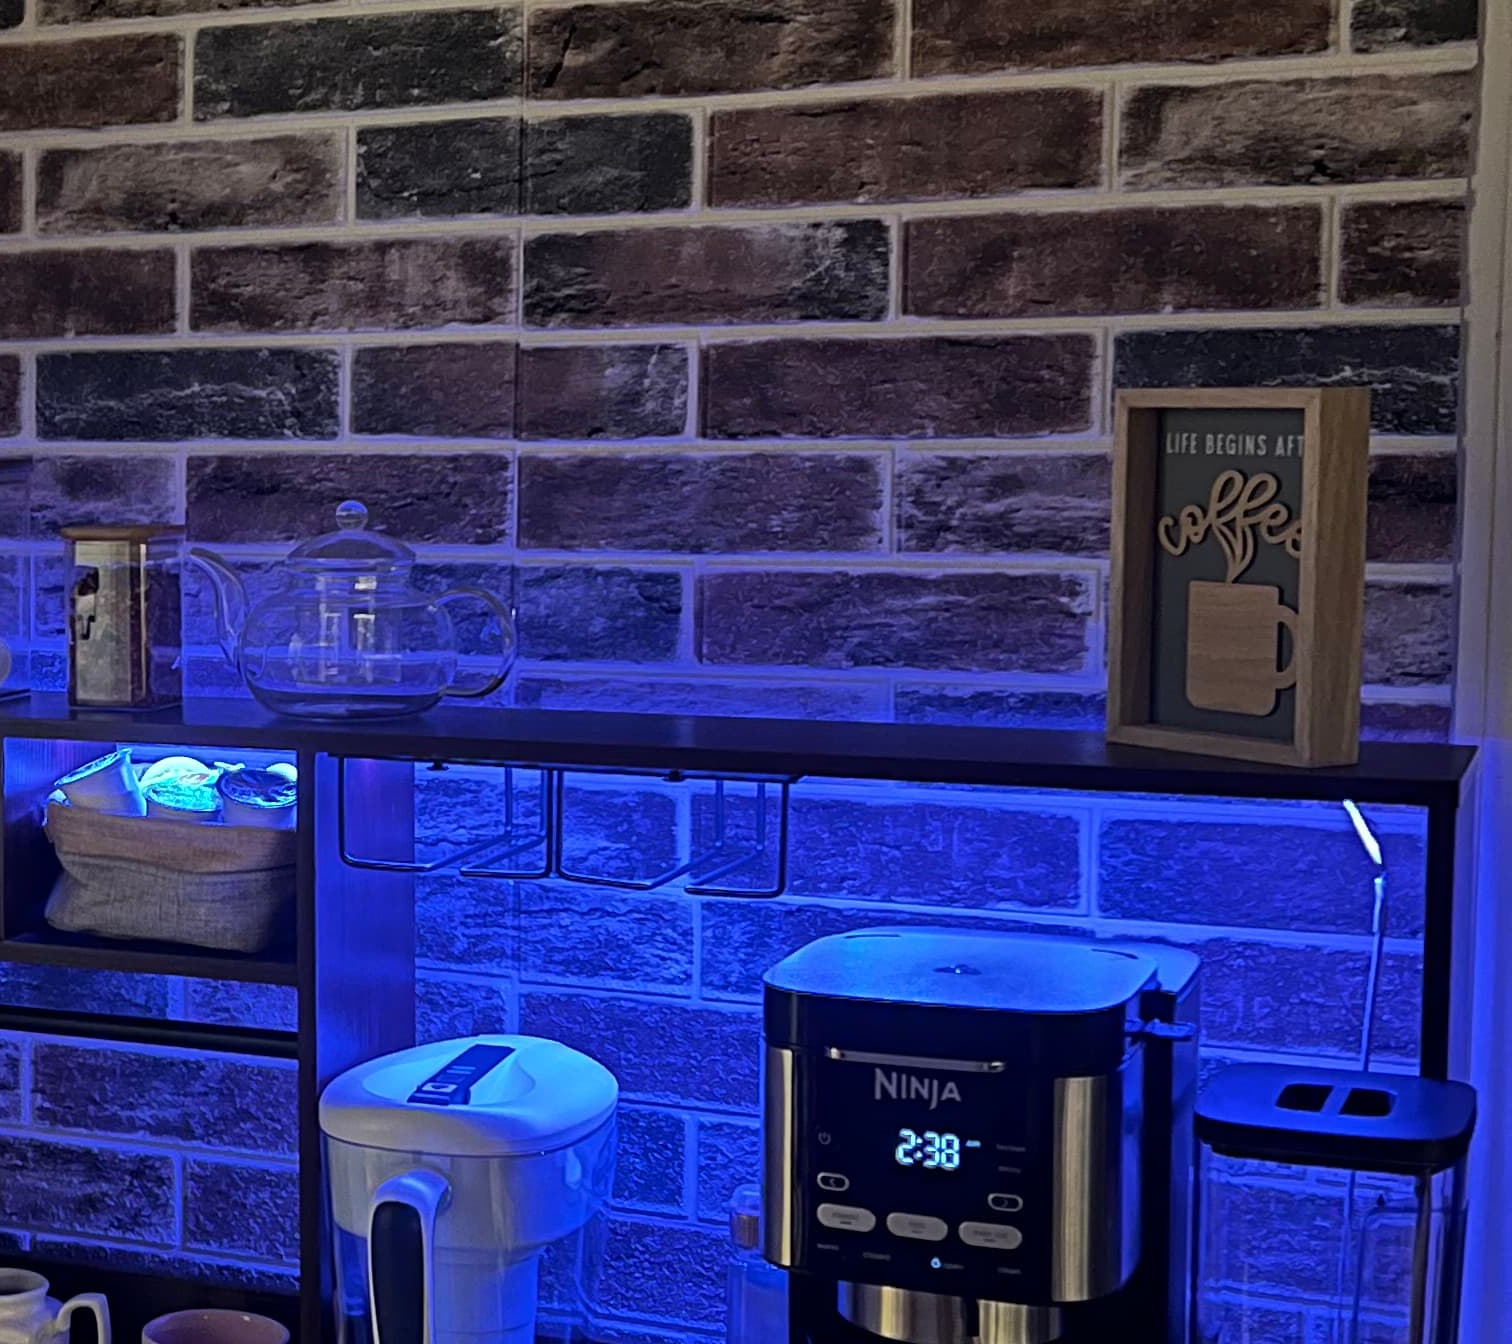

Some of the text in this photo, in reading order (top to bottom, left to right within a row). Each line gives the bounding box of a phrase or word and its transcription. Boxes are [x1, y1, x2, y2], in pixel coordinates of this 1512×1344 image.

[1166, 432, 1198, 454] LIFE
[1205, 433, 1267, 455] BEGINS
[874, 1067, 962, 1110] NINJA
[895, 1128, 960, 1170] 2:38
